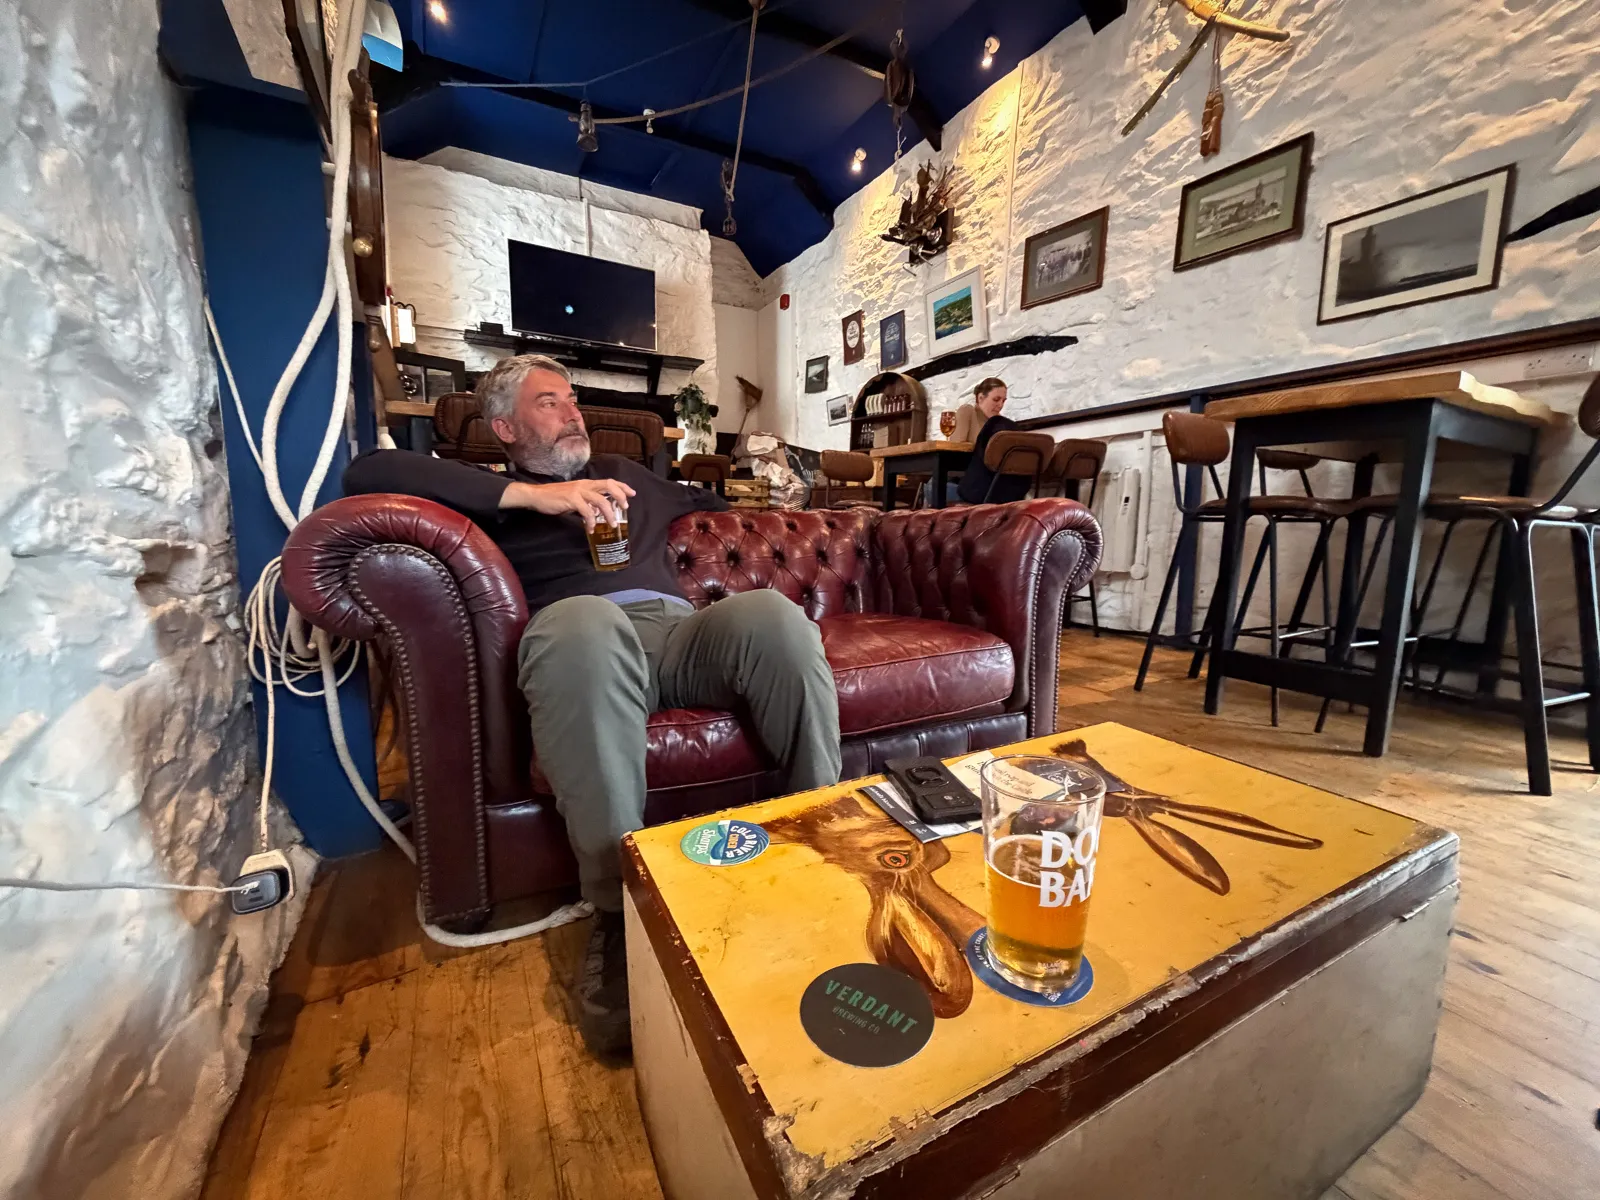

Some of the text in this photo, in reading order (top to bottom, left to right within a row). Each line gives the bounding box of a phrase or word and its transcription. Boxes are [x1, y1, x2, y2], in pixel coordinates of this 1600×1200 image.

[725, 825, 758, 858] COLD RIVER
[1040, 825, 1099, 869] DO
[1038, 865, 1095, 908] BA
[825, 980, 918, 1034] VERDANT
[832, 1005, 868, 1029] BREWING
